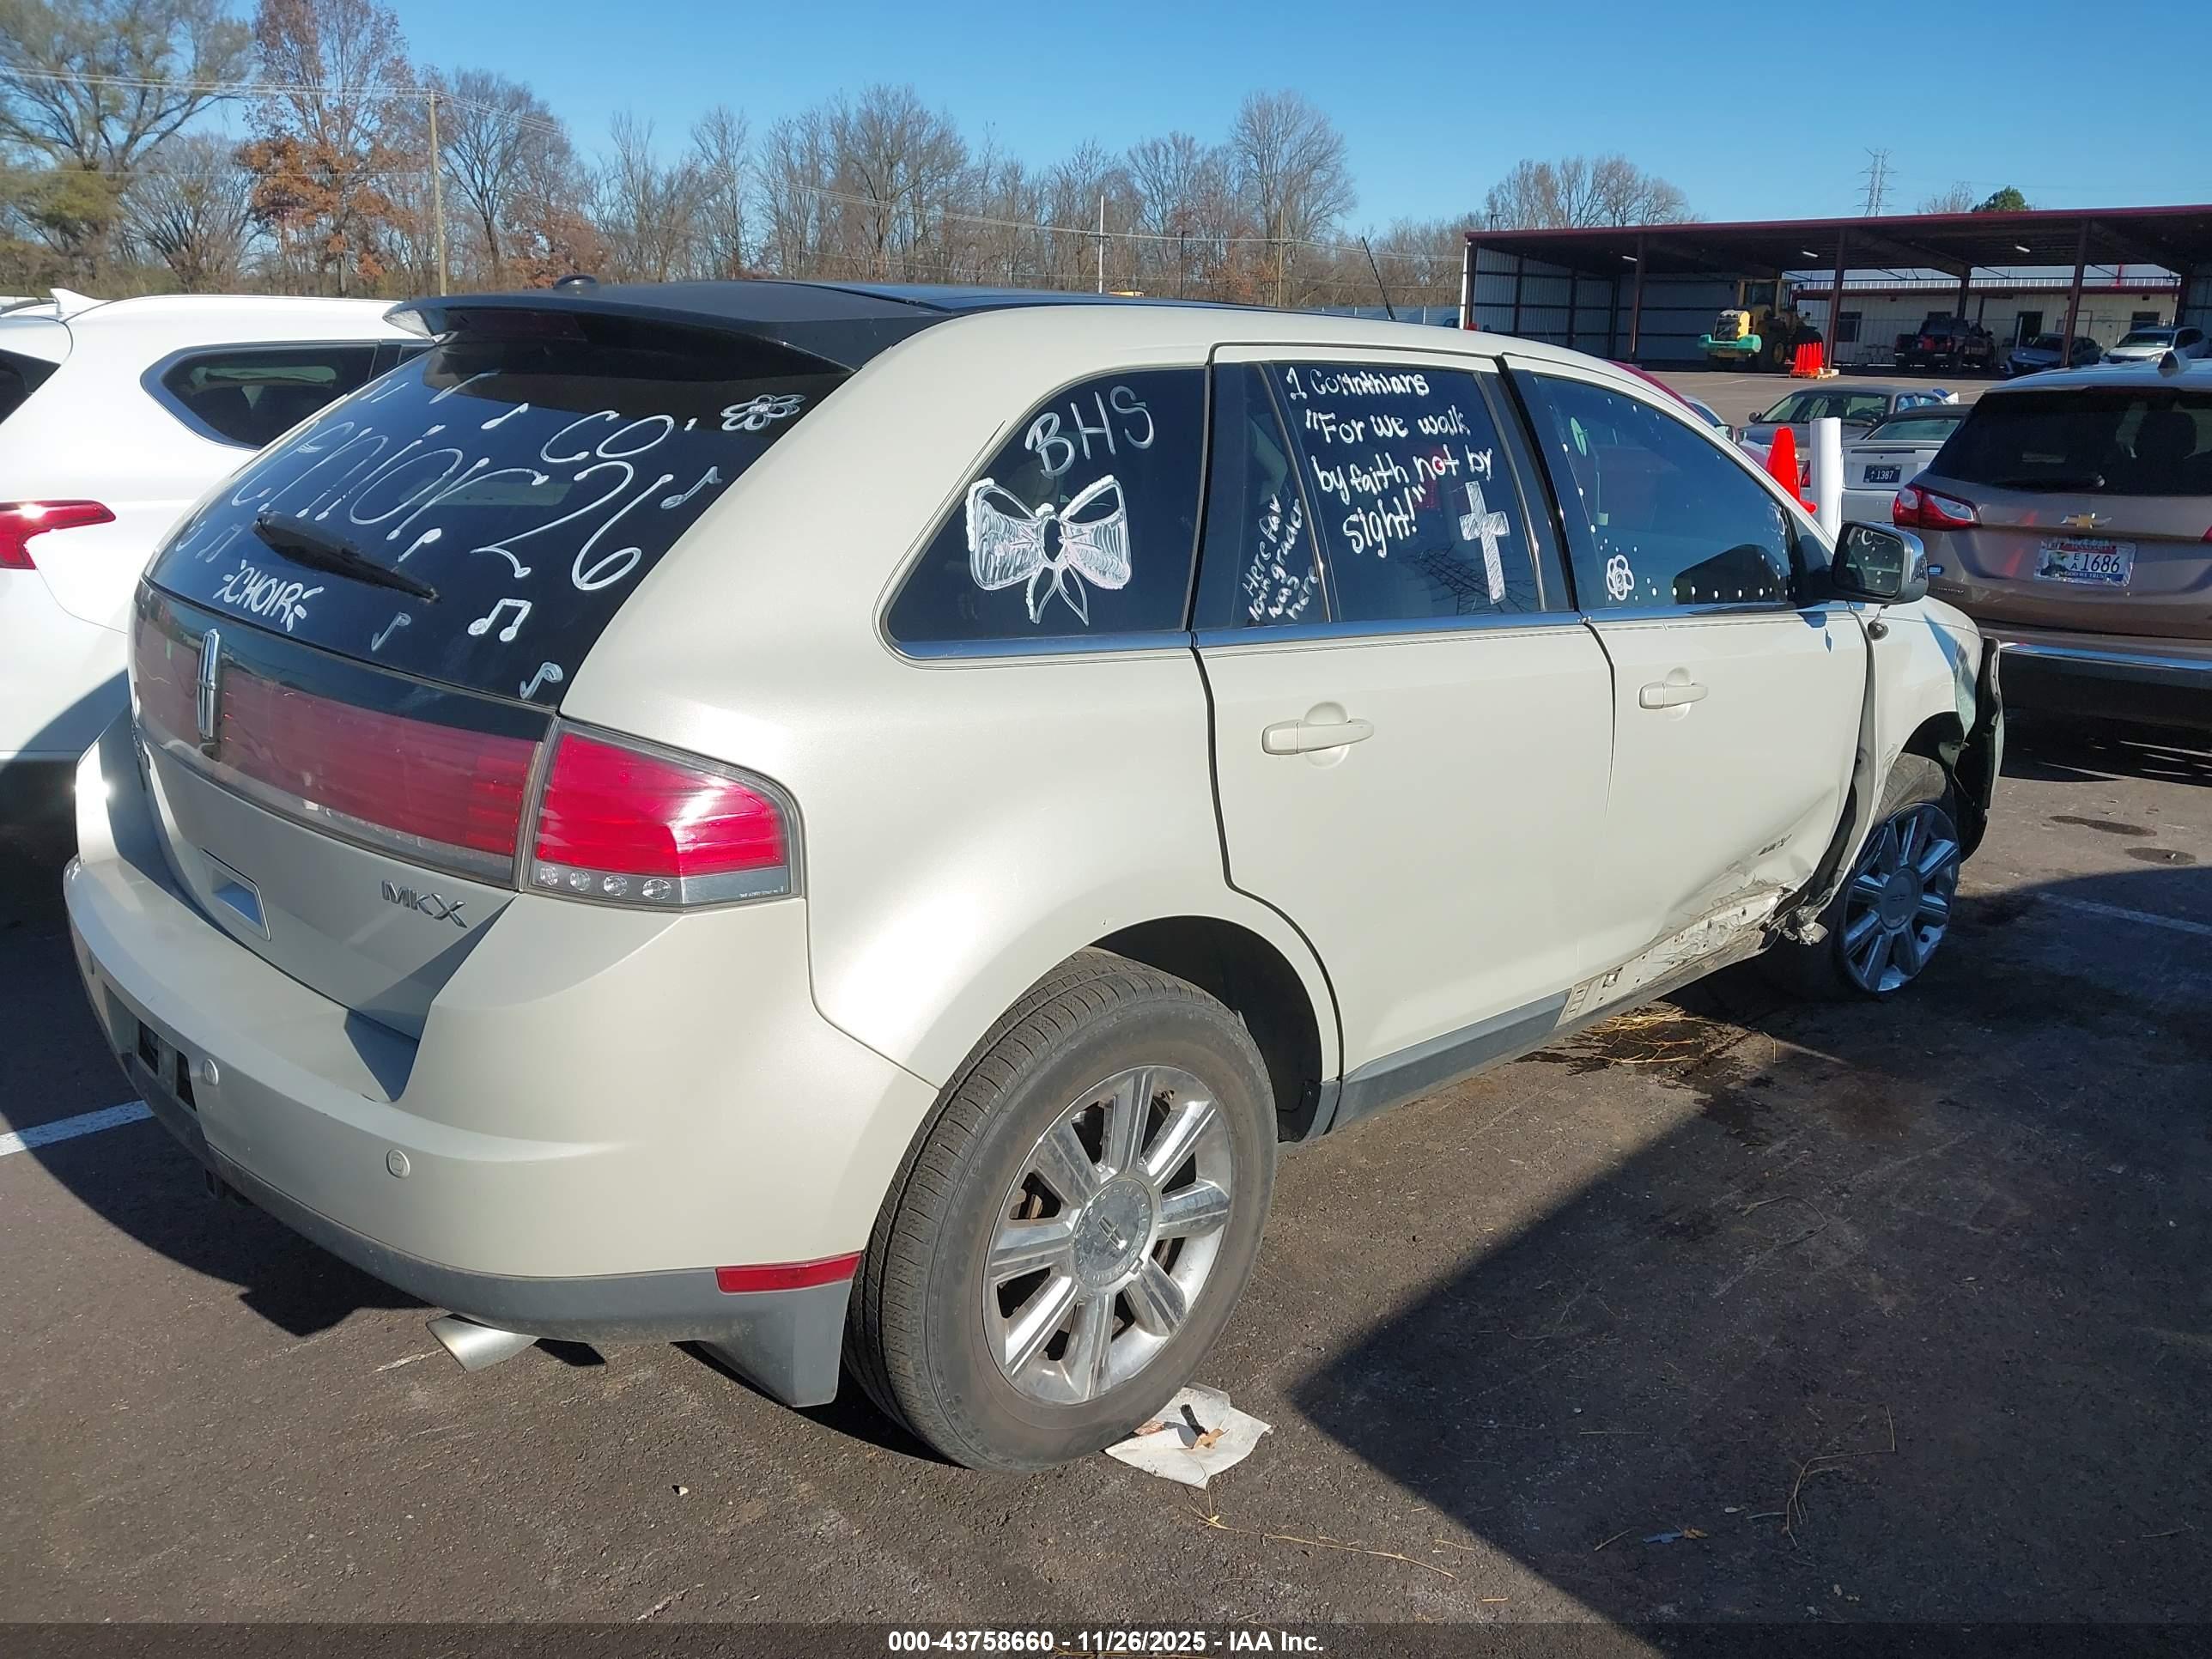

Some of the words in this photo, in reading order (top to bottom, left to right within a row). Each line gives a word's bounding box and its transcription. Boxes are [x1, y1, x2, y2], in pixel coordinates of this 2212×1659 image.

[1285, 367, 1308, 400] 1
[1024, 386, 1155, 480] BHS
[1305, 408, 1365, 444] "For
[1370, 414, 1409, 438] we
[1417, 404, 1472, 436] walk
[1310, 455, 1351, 506] by
[1349, 452, 1411, 495] faith
[1413, 443, 1460, 483] not
[1465, 444, 1493, 483] by
[469, 460, 676, 591] 26
[1270, 498, 1303, 585] grader
[2080, 554, 2120, 574] 1686
[222, 567, 304, 624] CHOIR
[1268, 575, 1300, 619] was
[1286, 565, 1319, 620] here
[381, 879, 468, 929] MKX
